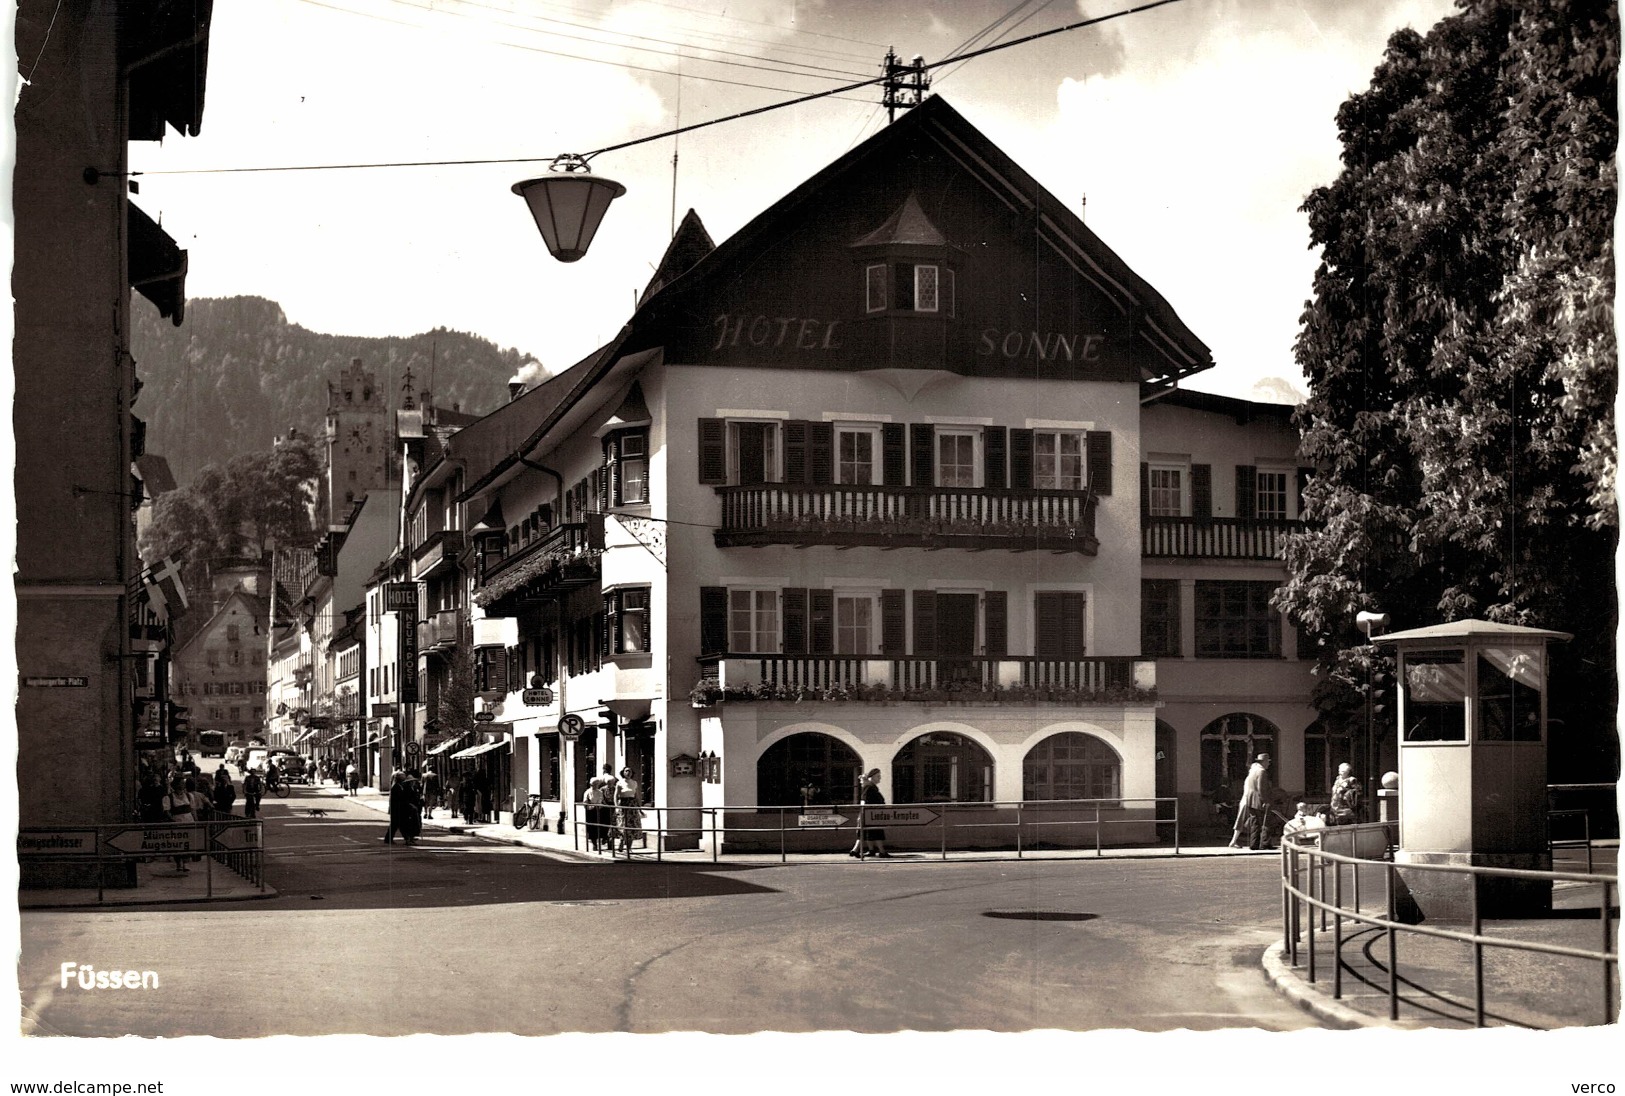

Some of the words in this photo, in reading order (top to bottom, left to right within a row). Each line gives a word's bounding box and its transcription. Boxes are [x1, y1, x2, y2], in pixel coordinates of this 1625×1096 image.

[713, 313, 842, 350] HOTEL
[976, 328, 1105, 362] SONNE
[389, 591, 417, 604] HOTEL
[143, 830, 189, 840] München
[141, 841, 190, 850] Augsburg
